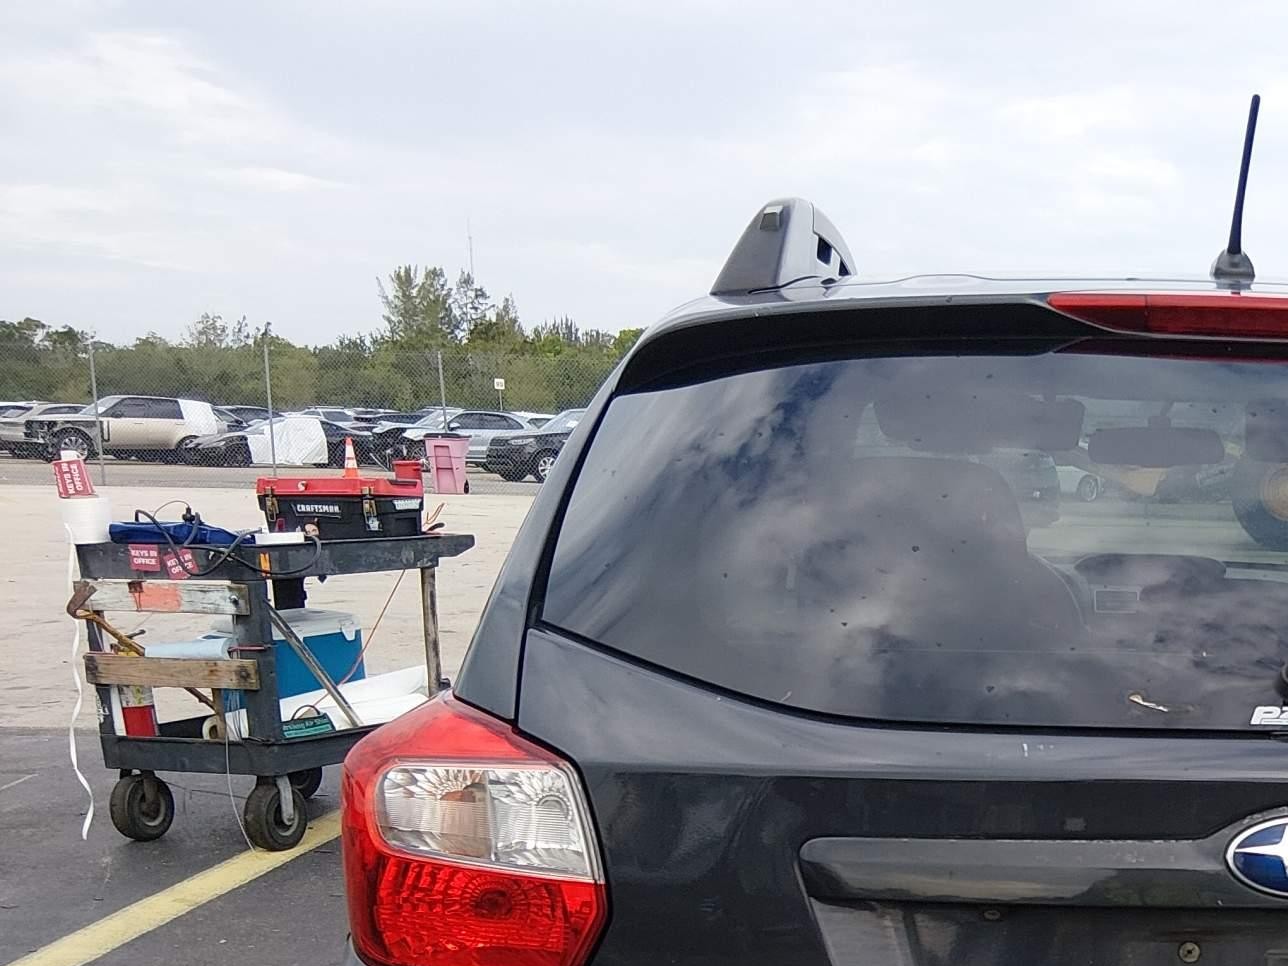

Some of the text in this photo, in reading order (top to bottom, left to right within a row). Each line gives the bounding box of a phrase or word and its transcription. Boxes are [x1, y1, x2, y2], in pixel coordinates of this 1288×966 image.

[70, 463, 84, 491] OFFICE
[296, 504, 340, 513] CRAFTSMAN
[133, 557, 157, 565] OFFICE
